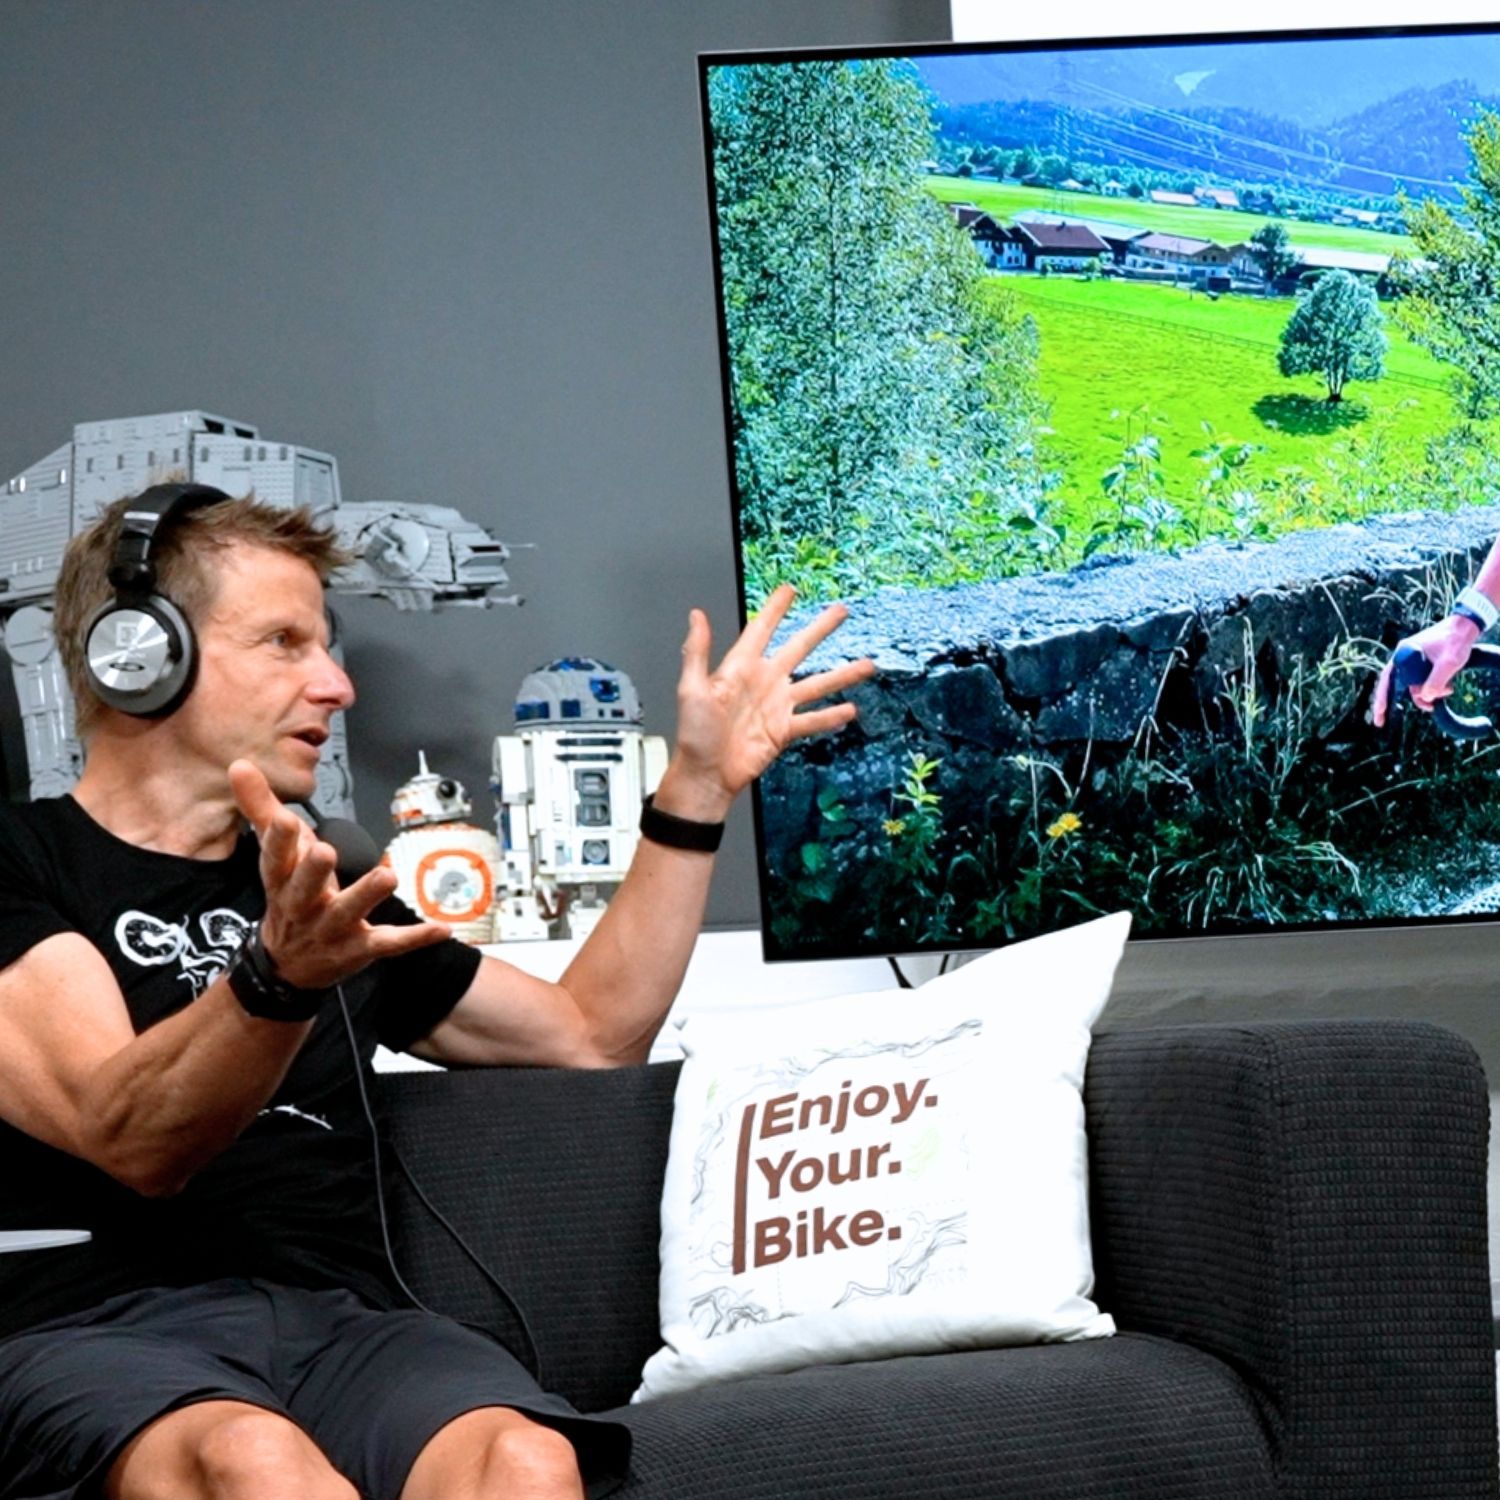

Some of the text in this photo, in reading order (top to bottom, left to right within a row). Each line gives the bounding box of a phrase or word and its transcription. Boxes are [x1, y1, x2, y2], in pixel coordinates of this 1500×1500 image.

[759, 1078, 939, 1141] Enjoy.
[755, 1142, 902, 1200] Your.
[753, 1206, 902, 1269] Bike.
